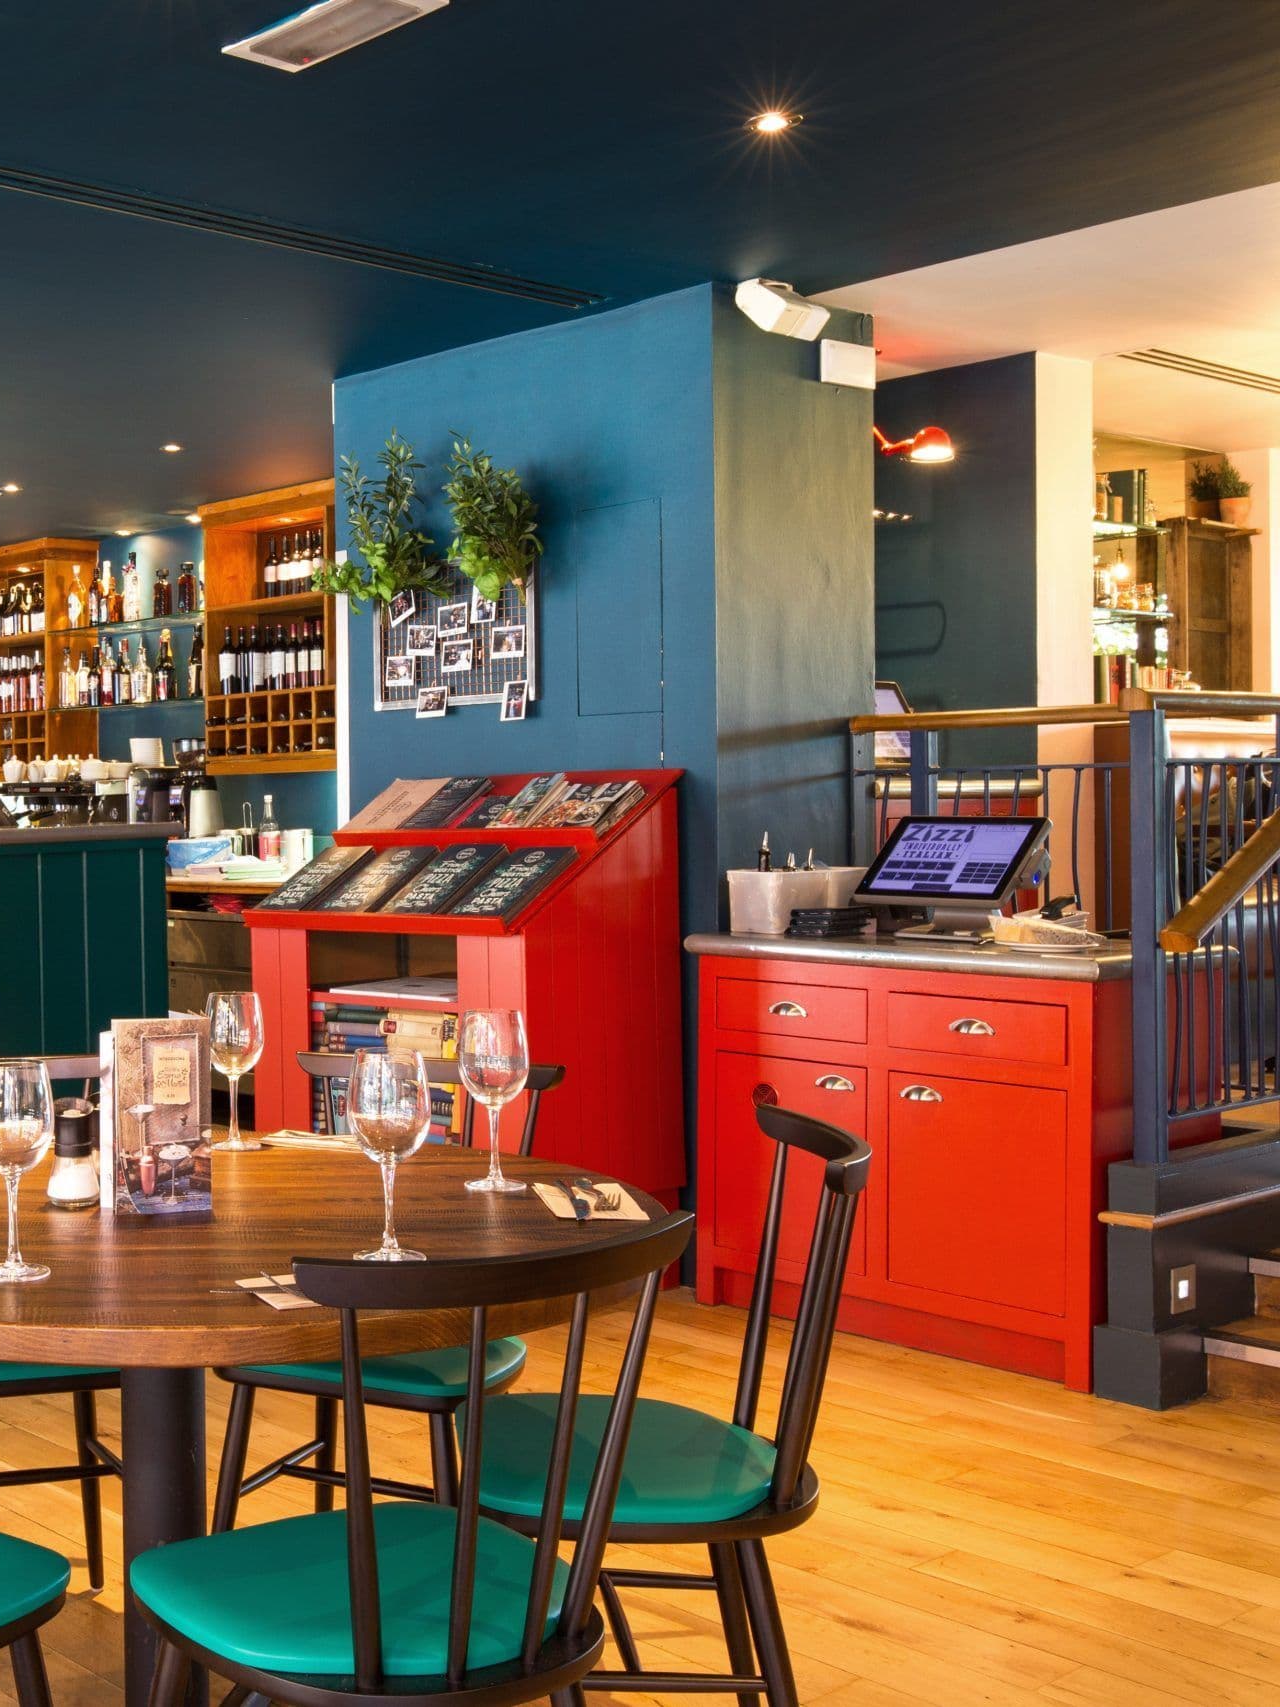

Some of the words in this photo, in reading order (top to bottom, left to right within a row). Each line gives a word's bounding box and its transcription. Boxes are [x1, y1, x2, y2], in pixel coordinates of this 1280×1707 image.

[902, 824, 976, 843] Zizzi
[903, 842, 963, 851] INDIVIDUALLY
[902, 851, 952, 859] ITALIAN
[421, 874, 455, 884] PIZZA
[488, 877, 524, 888] PIZZA
[404, 893, 435, 903] PASTA
[470, 897, 504, 908] PASTA
